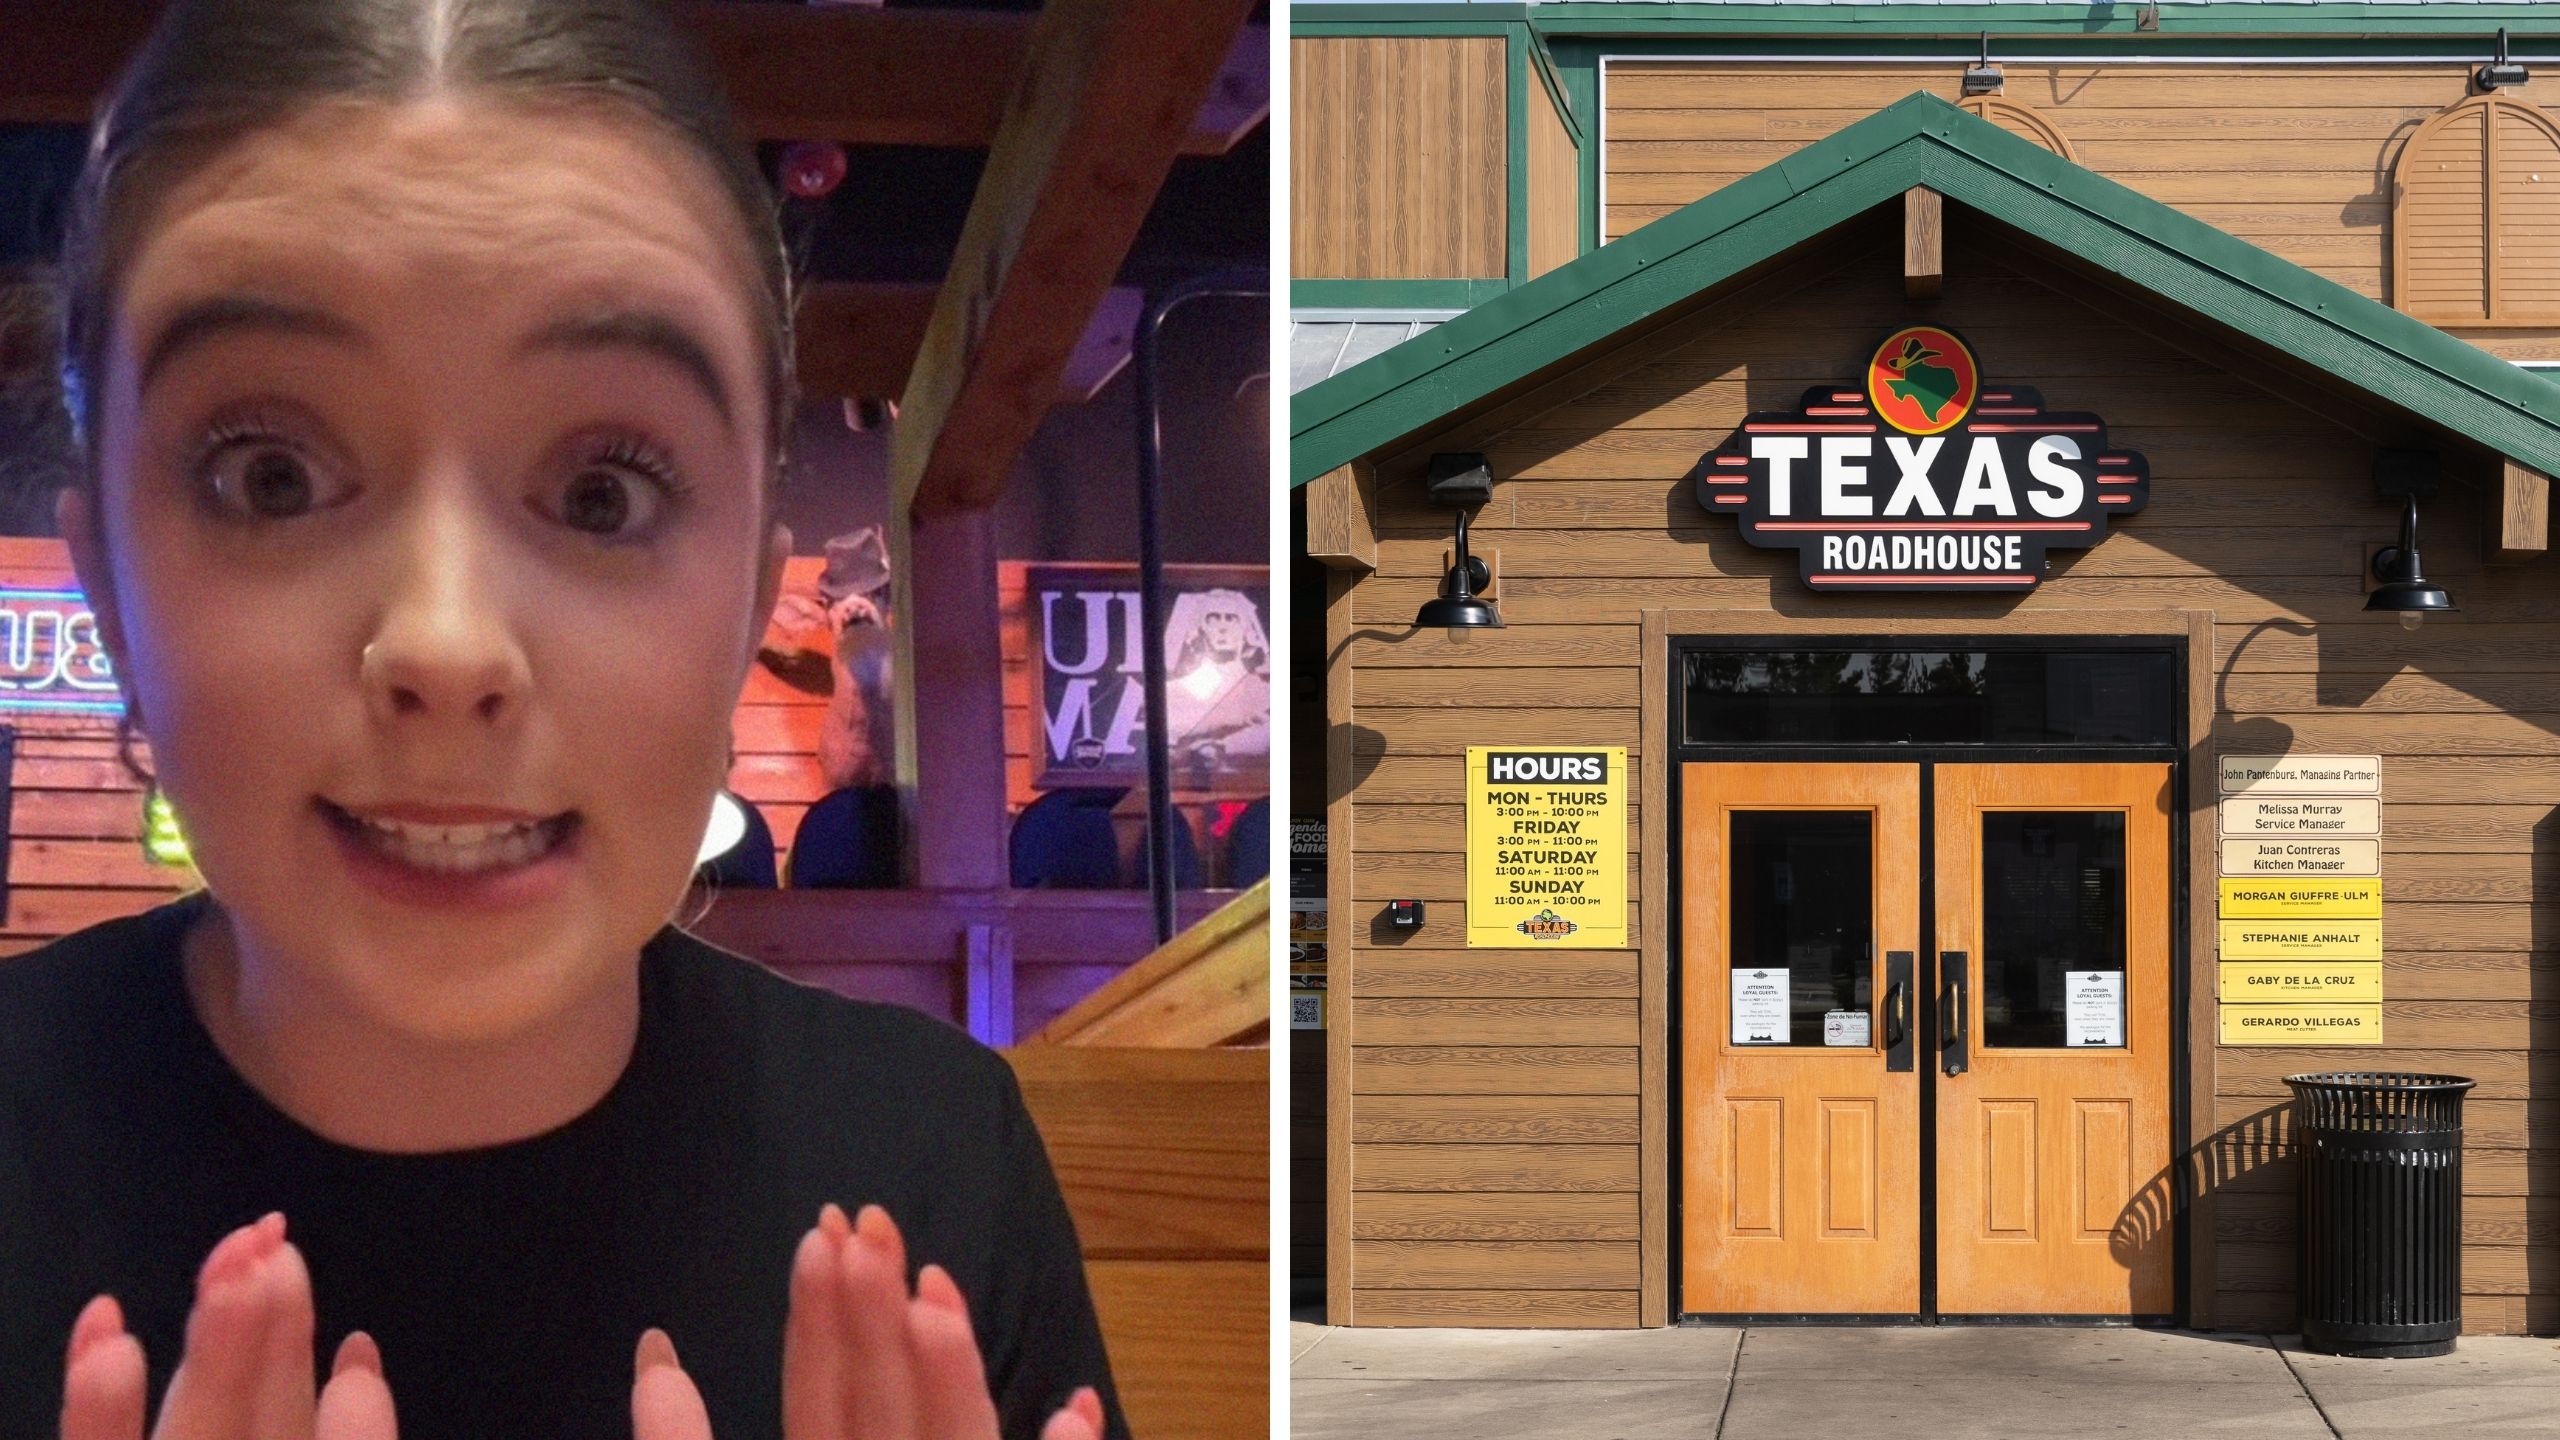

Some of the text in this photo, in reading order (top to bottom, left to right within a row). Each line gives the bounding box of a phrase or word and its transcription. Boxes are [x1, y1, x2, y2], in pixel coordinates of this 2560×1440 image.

[1751, 435, 2084, 518] TEXAS
[1823, 535, 2022, 570] ROADHOUSE
[1493, 757, 1601, 780] HOURS
[2224, 769, 2243, 780] John
[2301, 770, 2341, 780] Managing
[2344, 770, 2375, 780] Partner
[1488, 792, 1529, 805] MON
[1547, 792, 1607, 805] THURS
[1497, 808, 1524, 816] 3:00
[1552, 808, 1584, 816] 10:00
[2259, 805, 2342, 814] Melissa Murray
[1514, 821, 1580, 833] FRIDAY
[2256, 819, 2345, 829] Service Manager
[1497, 837, 1523, 845] 3:00
[1553, 837, 1582, 845] 11:00
[2258, 845, 2340, 855] Juan Contreras
[1499, 851, 1597, 863] SATURDAY
[2254, 860, 2345, 870] Kitchen Manager
[1496, 867, 1525, 875] 11:00
[1554, 867, 1583, 875] 11:00
[1510, 881, 1584, 893] SUNDAY
[1495, 897, 1524, 905] 11:00
[1553, 897, 1585, 905] 10:00
[2234, 892, 2368, 900] MORGAN GIUFFRE-ULM
[1525, 921, 1569, 934] TEXAS
[2243, 934, 2360, 942] STEPHANIE ANHALT
[2248, 976, 2280, 984] GABY
[2325, 976, 2355, 984] CRUZ
[2242, 1018, 2360, 1026] GERARDO VILLEGAS
